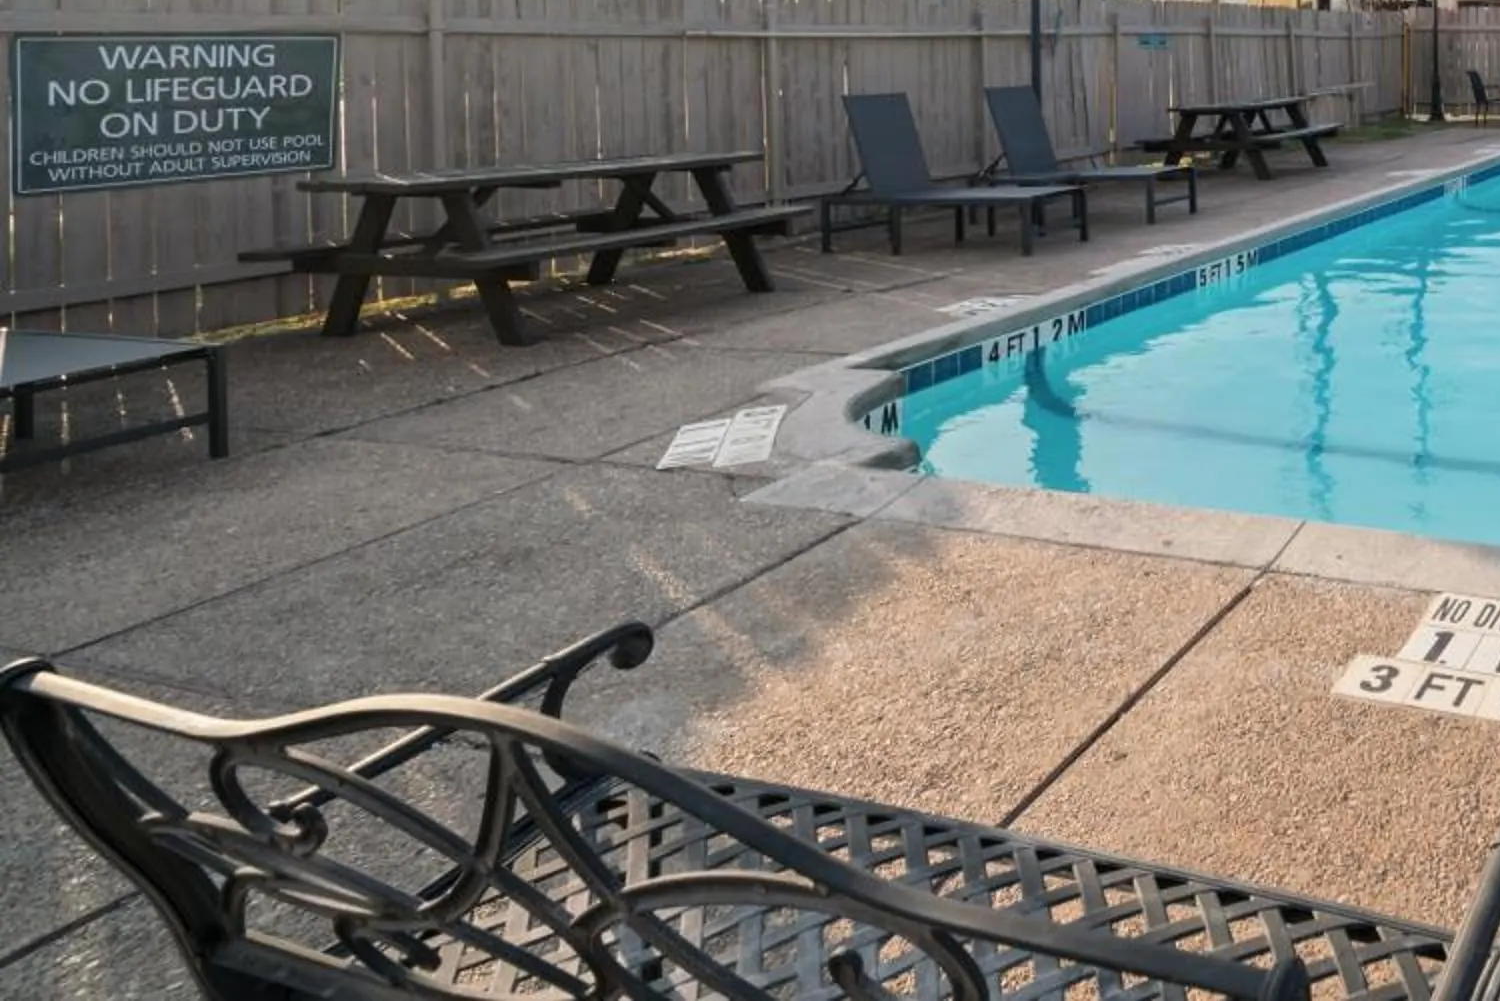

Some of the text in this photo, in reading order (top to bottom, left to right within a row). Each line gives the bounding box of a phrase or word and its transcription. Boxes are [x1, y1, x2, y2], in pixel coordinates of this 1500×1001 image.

[98, 44, 275, 70] WARNING
[48, 74, 313, 106] NO LIFEGUARD
[100, 106, 271, 138] ON DUTY
[29, 134, 324, 166] CHILDREN SHOULD NOT USE POOL
[48, 150, 311, 183] WITHOUT ADULT SUPERVISION
[1431, 596, 1473, 624] NO
[1359, 664, 1400, 693] 3
[1414, 673, 1485, 708] FT
